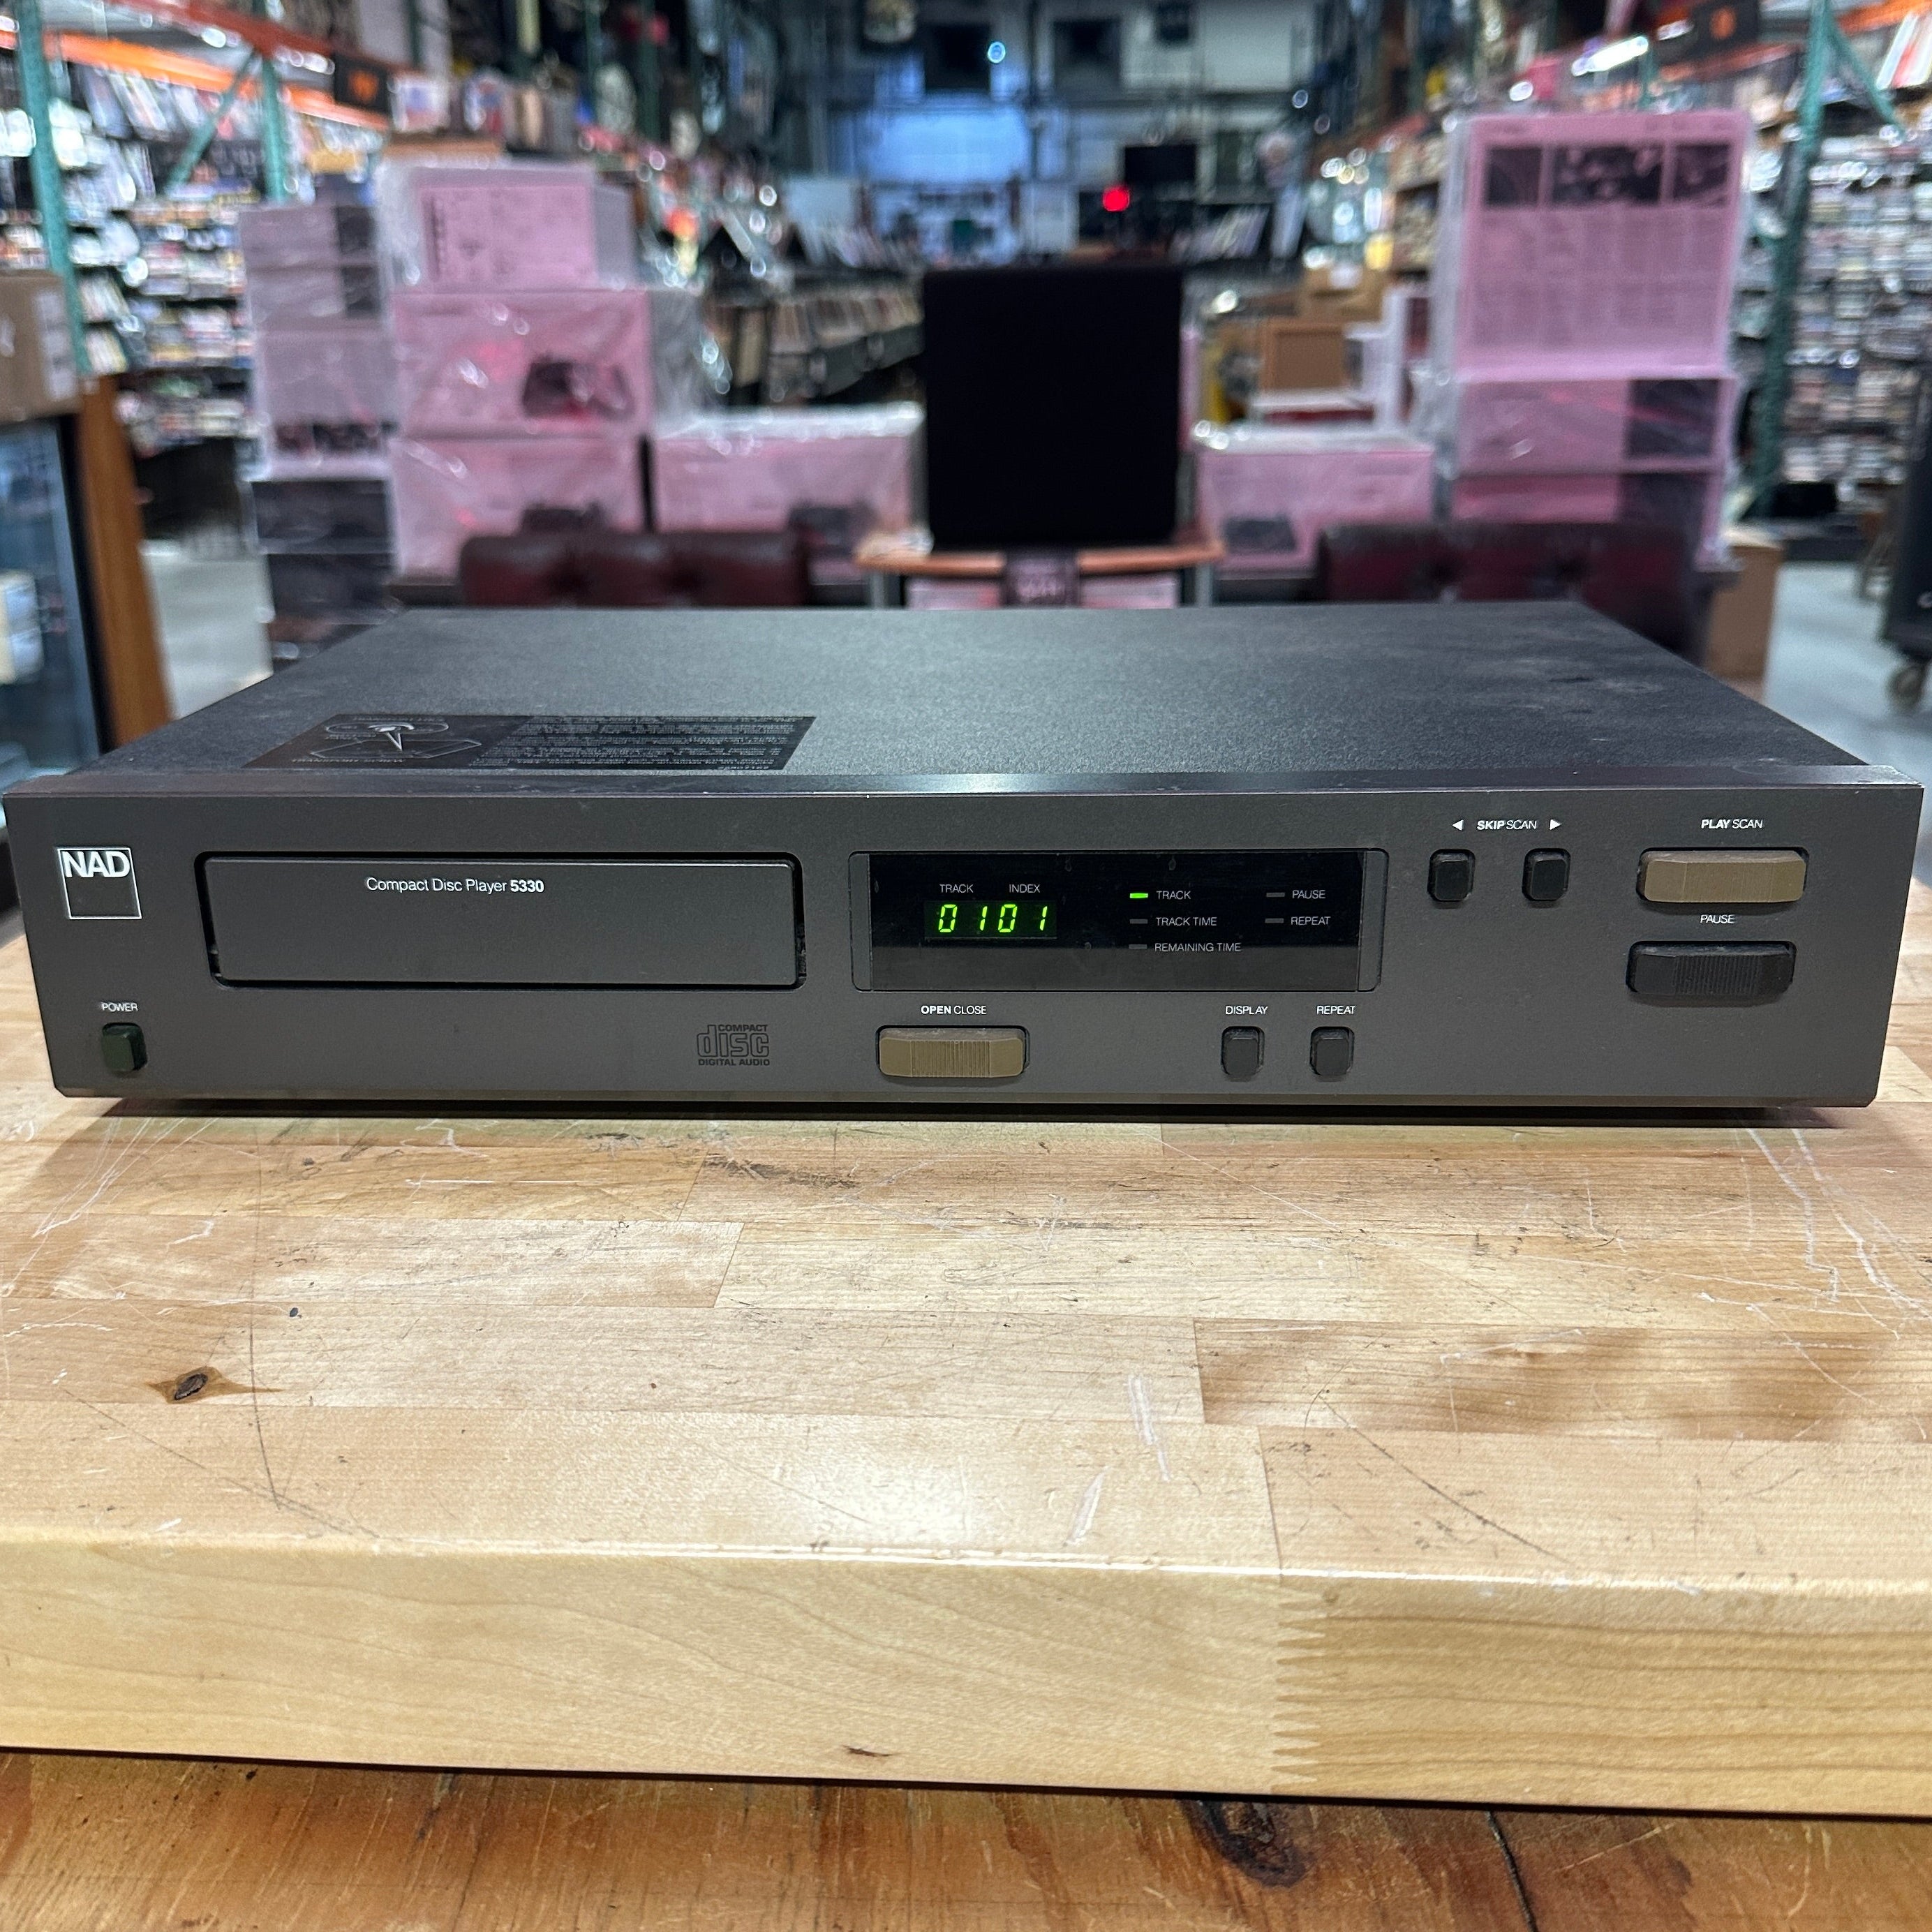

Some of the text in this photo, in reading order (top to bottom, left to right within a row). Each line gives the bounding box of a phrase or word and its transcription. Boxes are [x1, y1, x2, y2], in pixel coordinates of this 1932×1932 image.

[1476, 819, 1538, 831] SKIP SCAN
[1701, 818, 1763, 829] PLAY SCAN
[63, 850, 130, 879] NAD
[366, 877, 544, 895] Compact Disc Player 5330
[939, 884, 974, 893] TRACK
[1009, 883, 1041, 893] INDEX
[1156, 890, 1191, 900] TRACK
[1292, 889, 1326, 900] PAUSE
[1155, 916, 1217, 927] TRACK TIME
[1291, 916, 1331, 926] REPEAT
[1700, 914, 1735, 924] PAUSE
[1154, 943, 1242, 952] REMAINING TIME
[101, 1002, 138, 1012] POWER
[921, 1005, 987, 1016] OPEN CLOSE
[1225, 1005, 1268, 1015] DISPLAY
[1316, 1005, 1356, 1015] REPEAT
